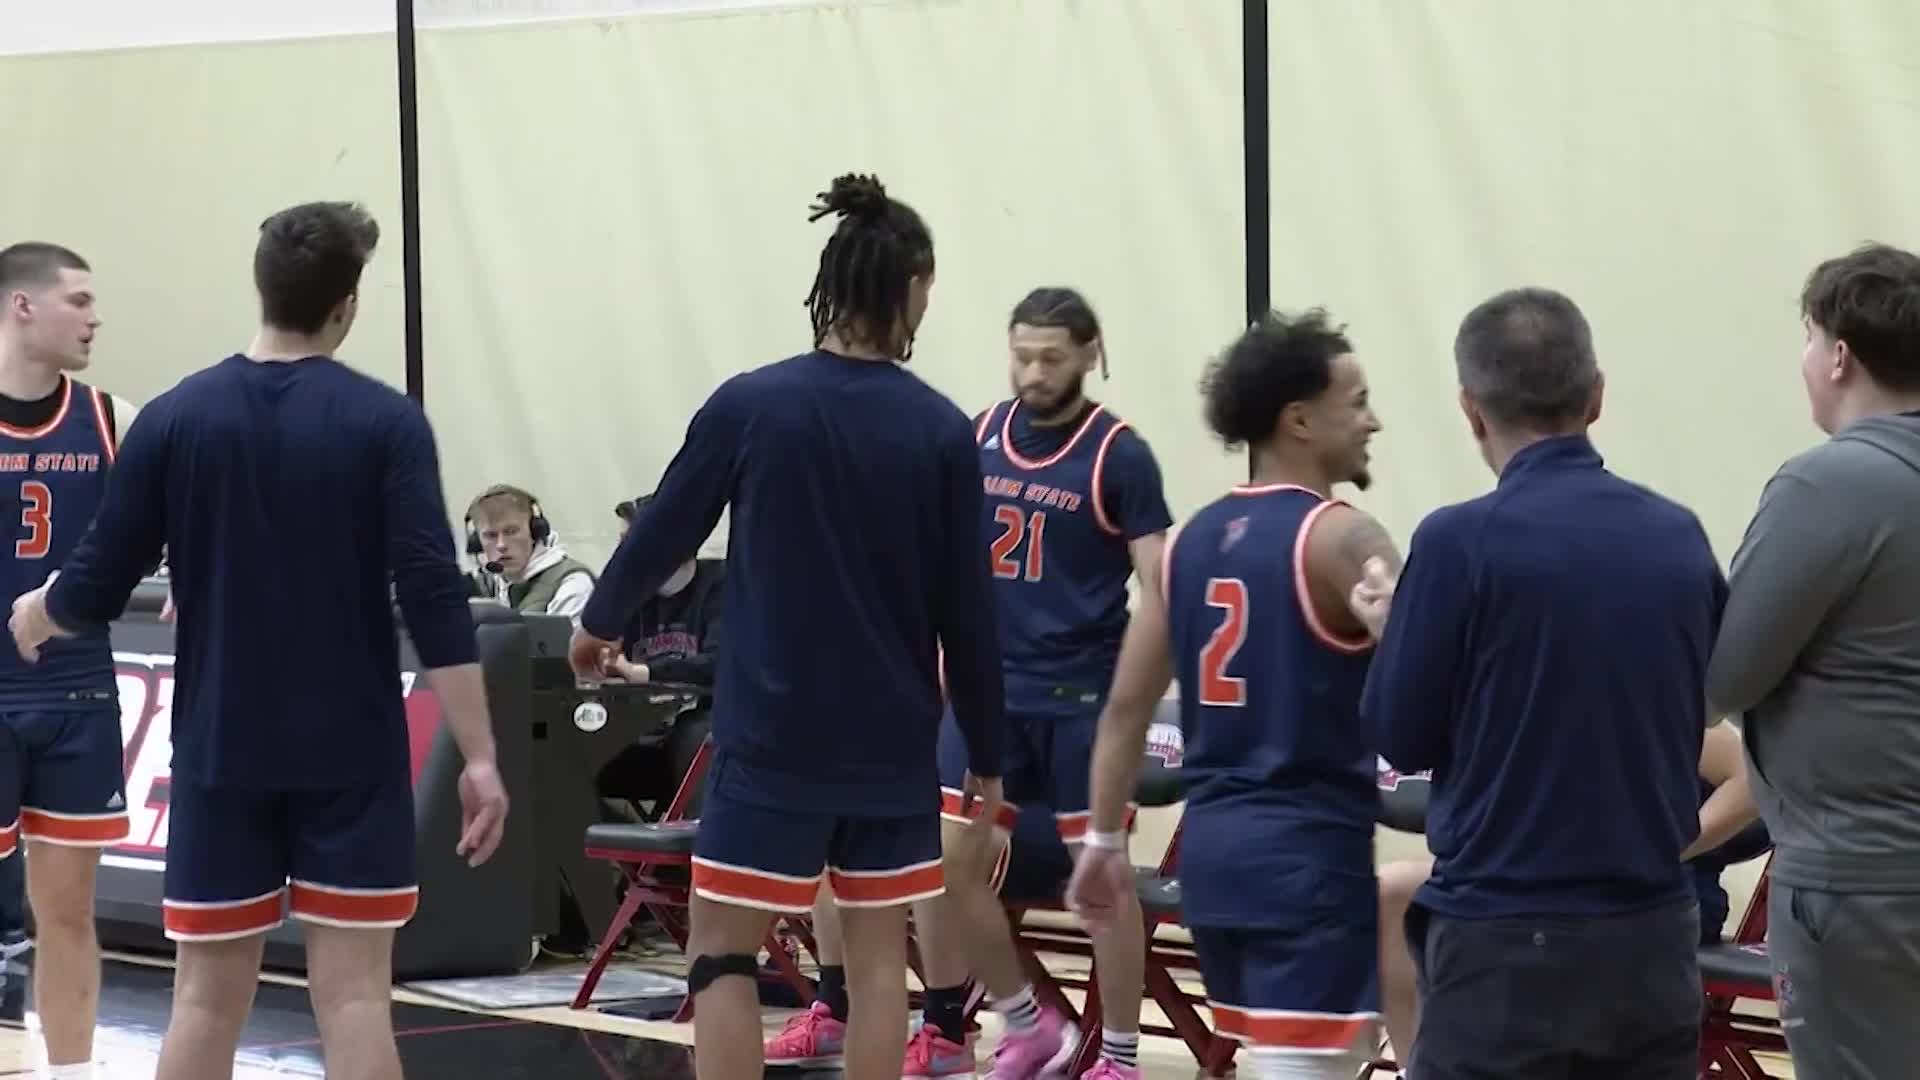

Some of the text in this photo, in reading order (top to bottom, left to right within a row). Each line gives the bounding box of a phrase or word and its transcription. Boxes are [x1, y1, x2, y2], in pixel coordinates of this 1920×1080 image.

[35, 453, 99, 472] STATE
[1024, 483, 1081, 512] STATE
[16, 481, 52, 558] 3
[991, 504, 1046, 582] 21
[1200, 578, 1248, 705] 2
